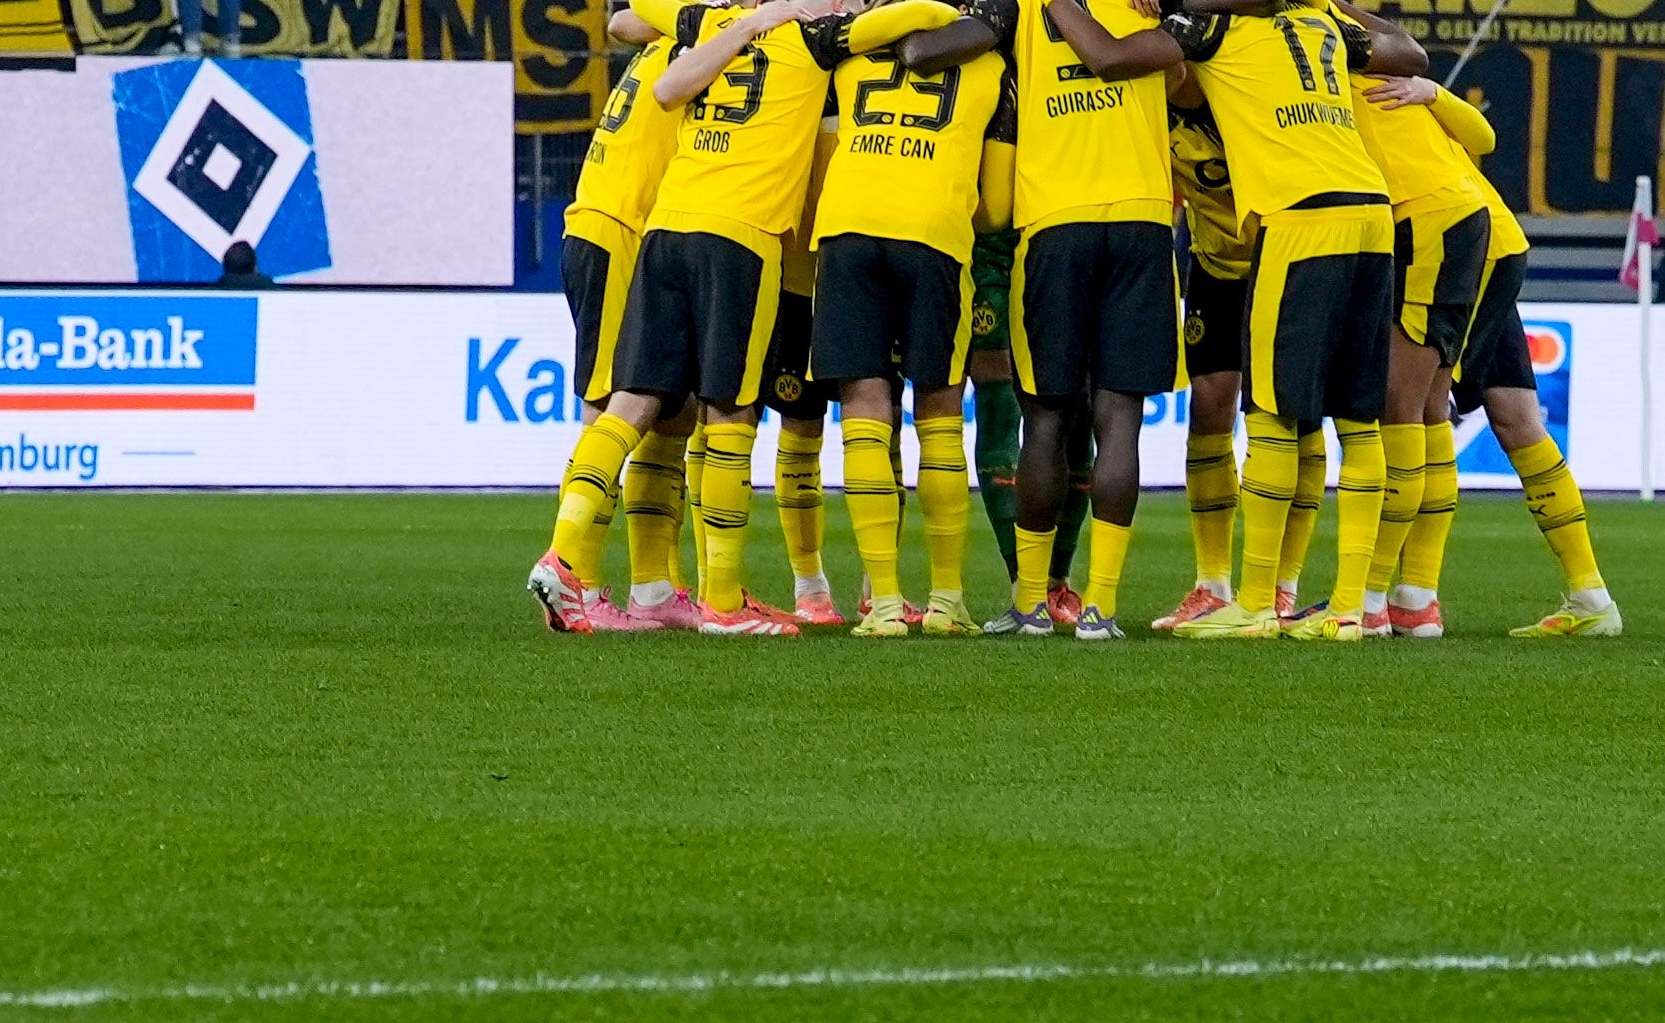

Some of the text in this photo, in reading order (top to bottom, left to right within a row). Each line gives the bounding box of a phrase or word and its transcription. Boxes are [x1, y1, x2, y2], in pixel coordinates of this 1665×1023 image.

[1506, 21, 1626, 42] TRADITION
[1273, 16, 1340, 96] 17
[852, 49, 962, 133] 23
[1046, 85, 1124, 118] GUIRASSY
[849, 133, 936, 161] EMRE CAN
